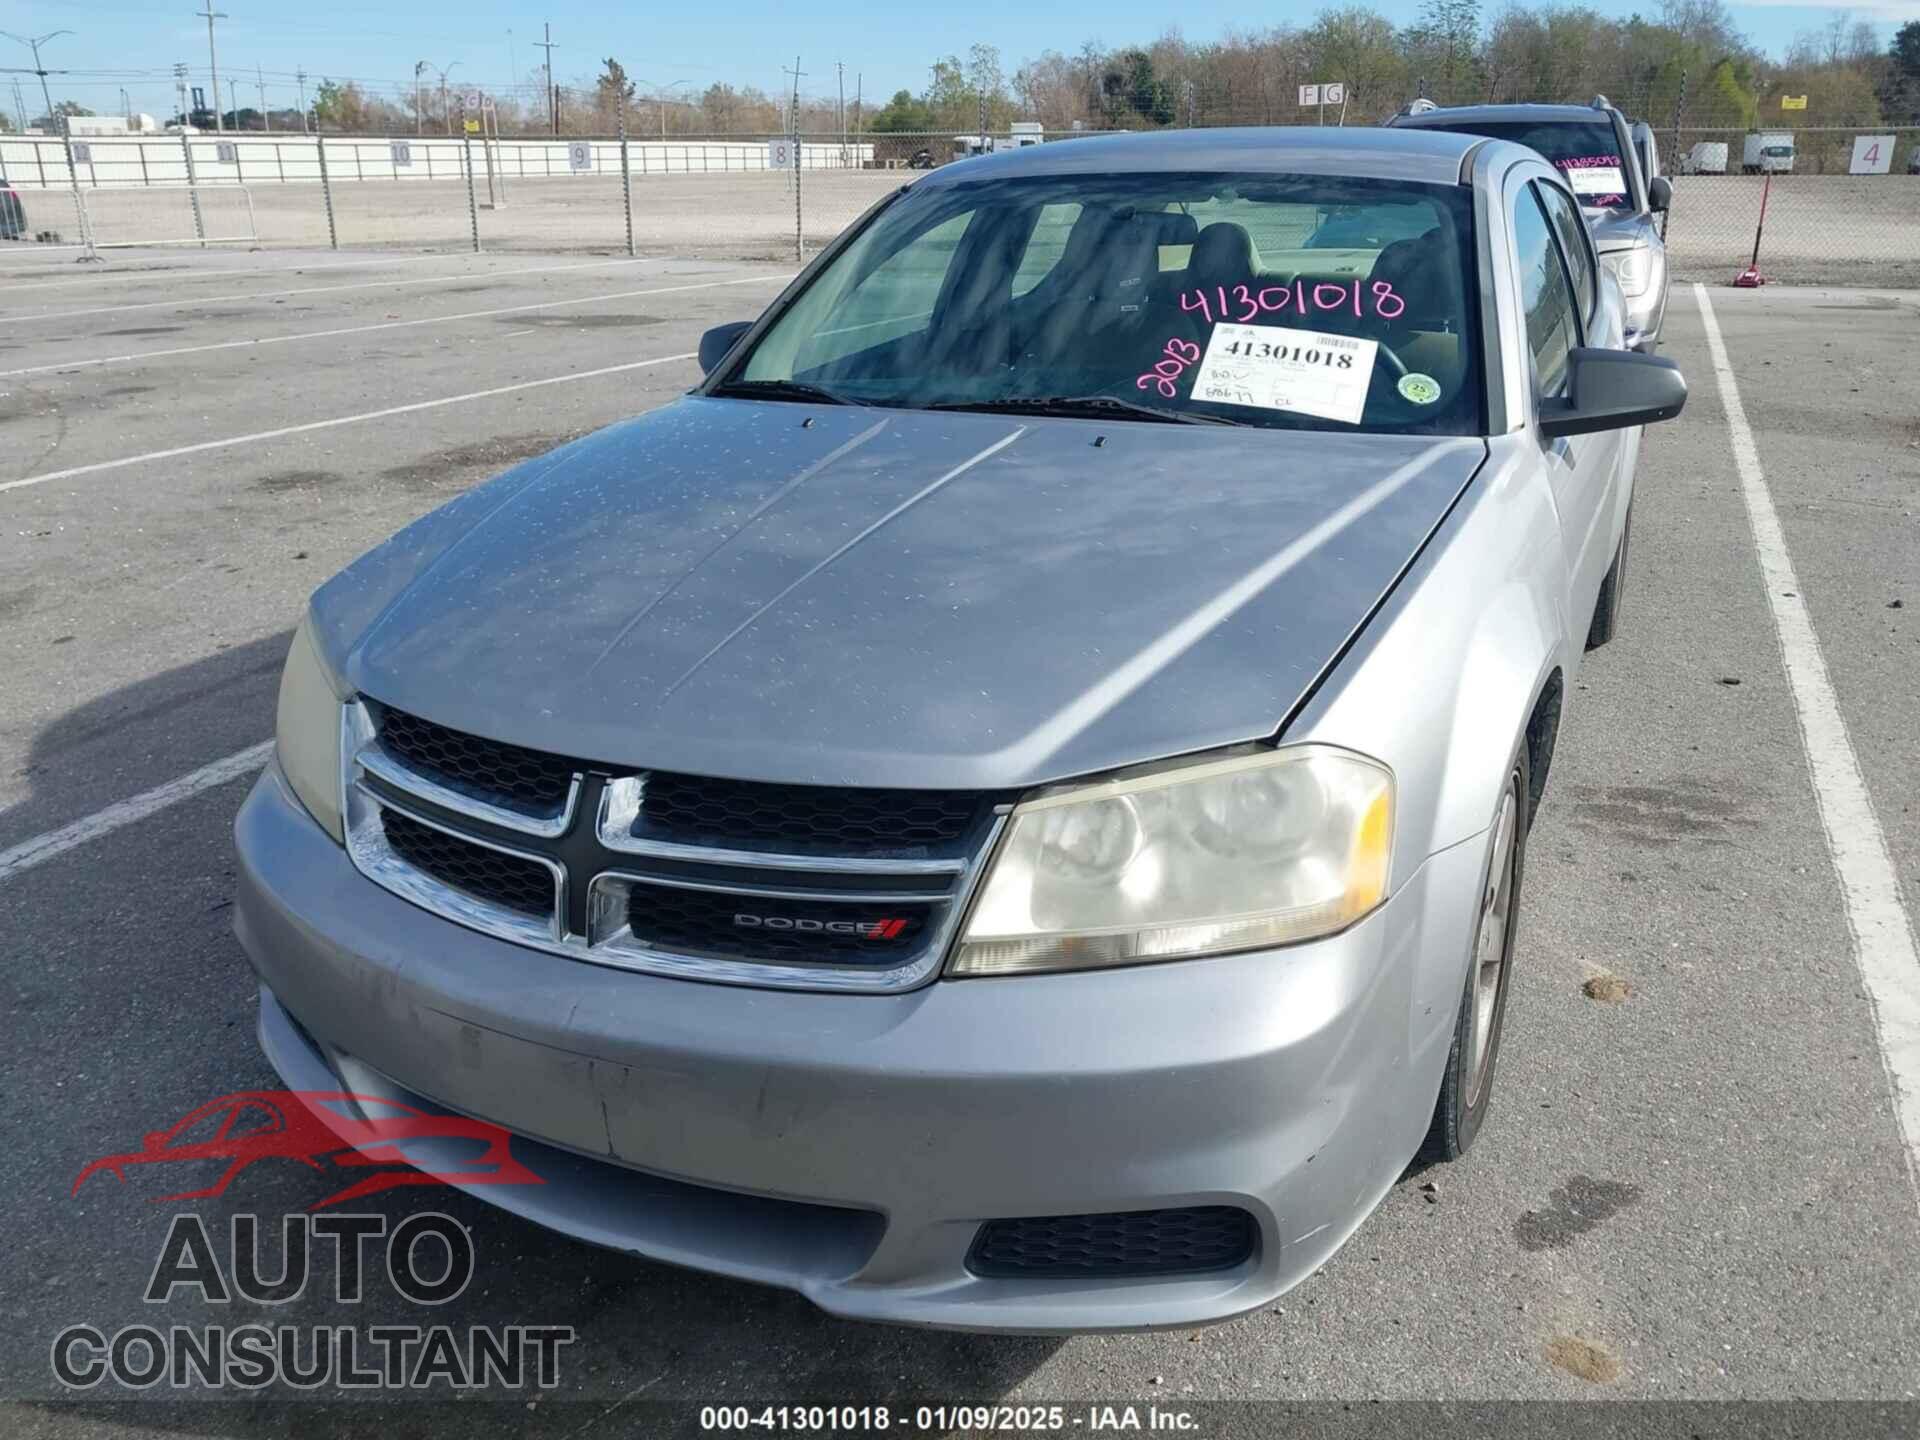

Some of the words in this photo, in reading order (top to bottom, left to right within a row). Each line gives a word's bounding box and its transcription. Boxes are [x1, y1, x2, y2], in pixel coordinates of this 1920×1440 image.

[1303, 86, 1313, 104] F
[1327, 84, 1340, 102] G
[393, 147, 410, 162] 10
[574, 147, 585, 164] 9
[776, 146, 786, 163] 8
[1863, 143, 1880, 166] 4
[1180, 280, 1405, 322] 41301018
[1224, 340, 1353, 369] 41301018
[1136, 337, 1200, 398] 2013
[734, 913, 883, 934] DODGE
